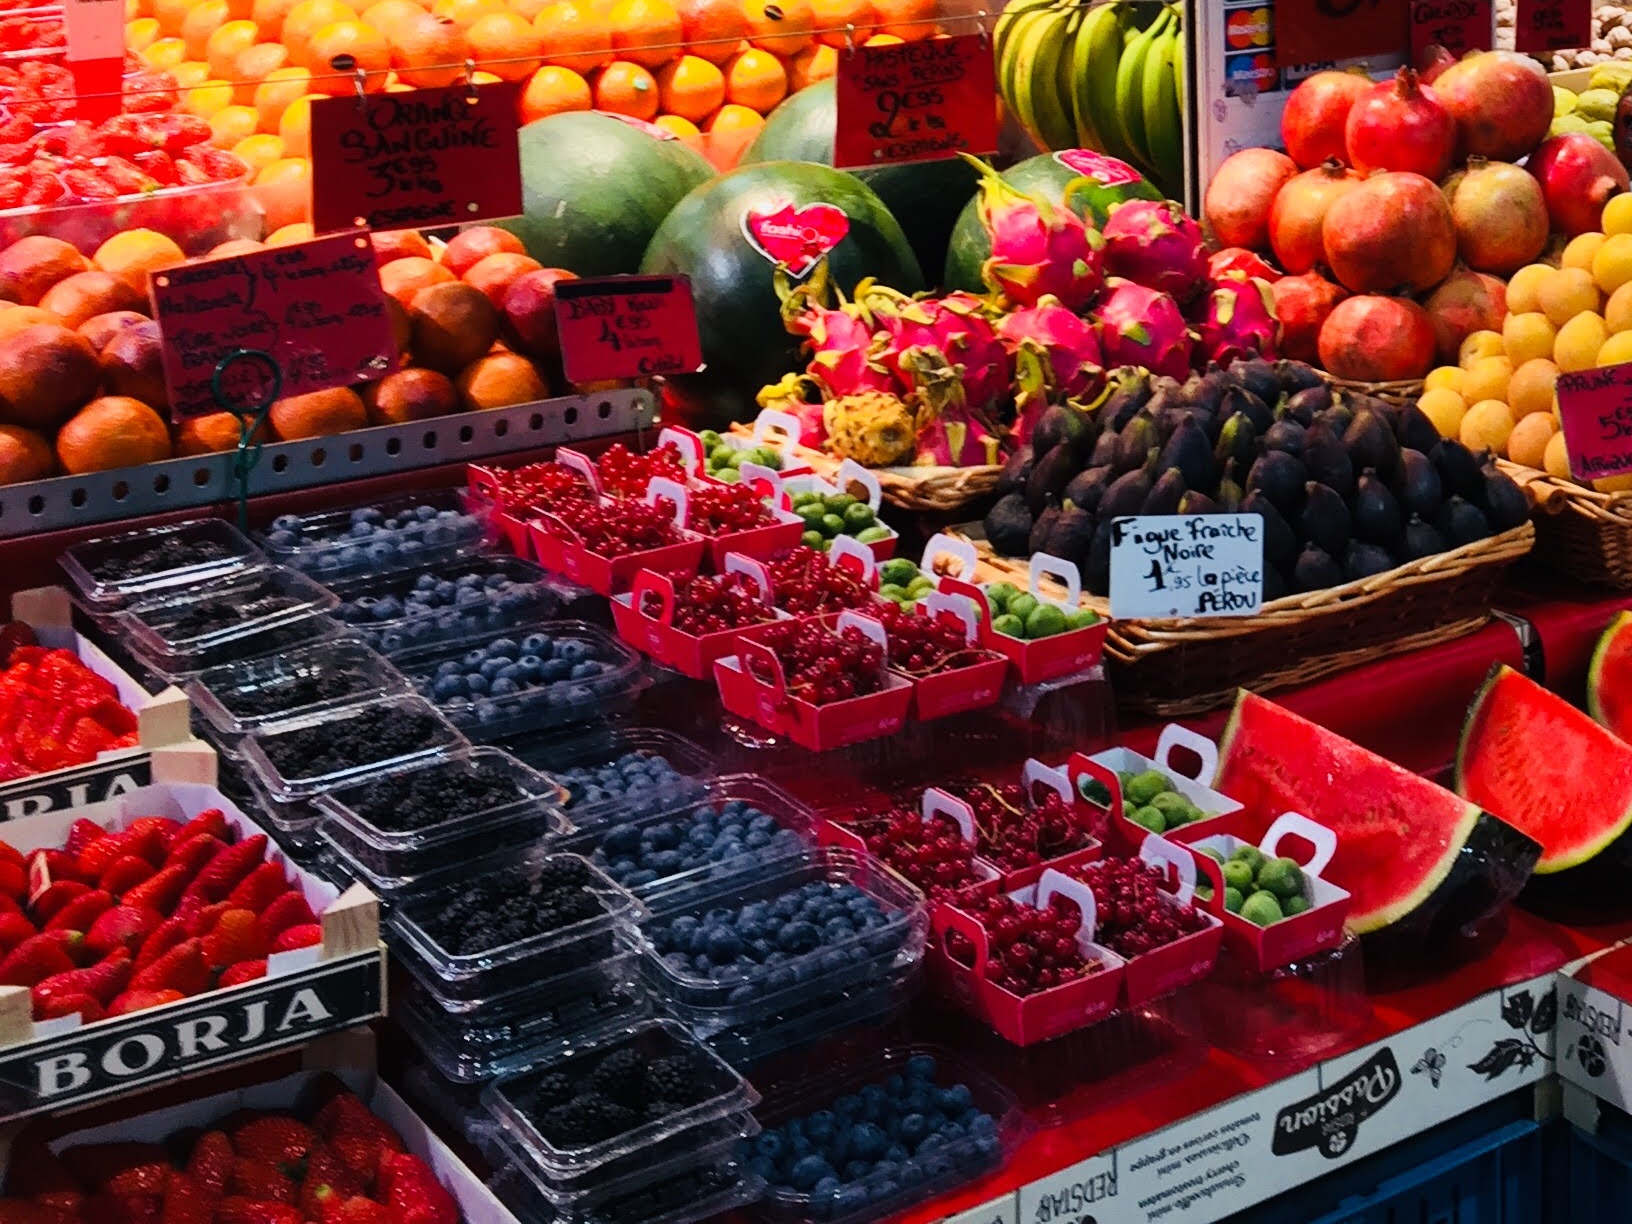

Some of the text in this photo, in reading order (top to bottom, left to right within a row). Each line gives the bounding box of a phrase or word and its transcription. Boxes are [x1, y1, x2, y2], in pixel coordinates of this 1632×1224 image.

[1112, 518, 1184, 554] Figue
[1163, 543, 1215, 564] Noire
[34, 986, 334, 1099] BORJA
[1278, 1060, 1398, 1136] Passion
